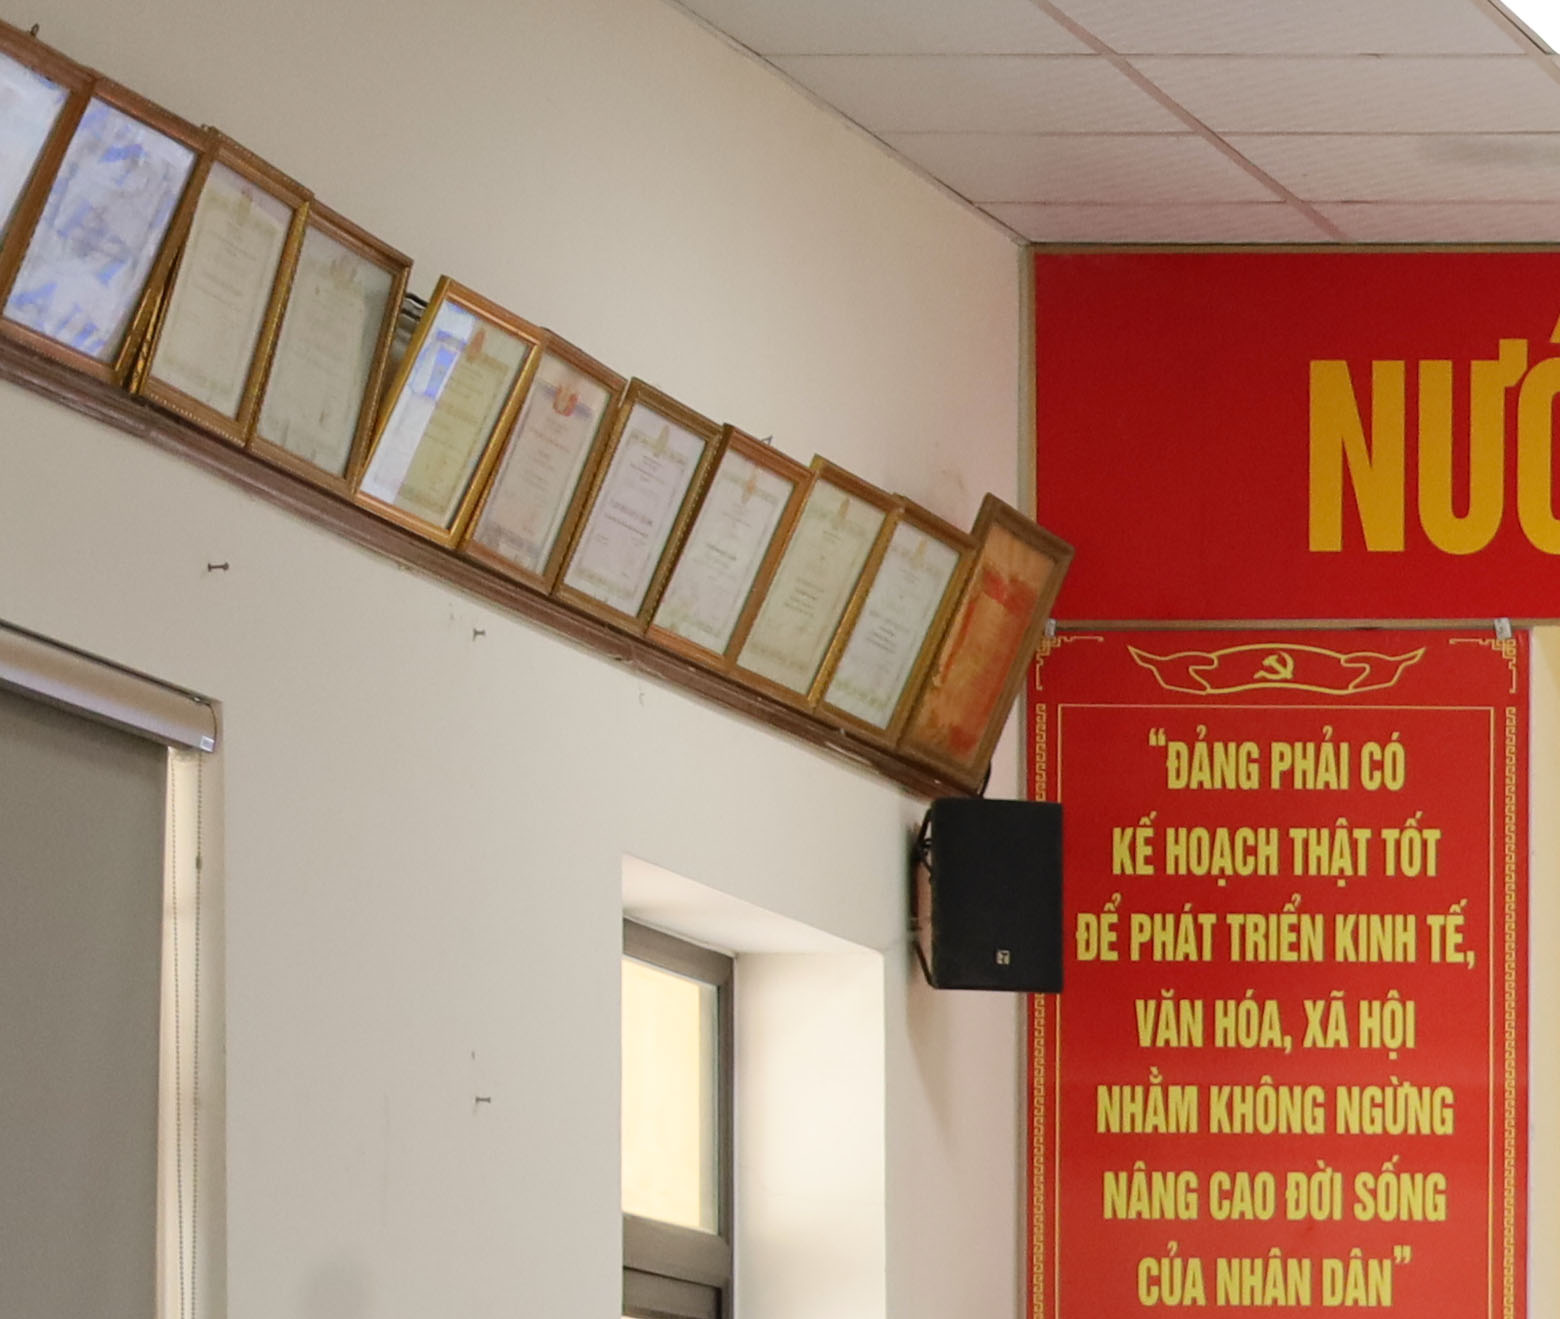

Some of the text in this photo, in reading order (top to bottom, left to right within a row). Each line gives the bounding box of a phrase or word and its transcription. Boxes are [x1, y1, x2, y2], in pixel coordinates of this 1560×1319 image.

[1150, 725, 1404, 790] “ĐẢNG PHẢI CÓ
[1113, 812, 1441, 887] KẾ HOẠCH THẬT TỐT
[1077, 894, 1475, 969] ĐỂ PHÁT TRIỂN KINH TẾ,
[1136, 990, 1415, 1060] VĂN HÓA, XÃ HỘI
[1139, 1241, 1412, 1307] CỦA NHÂN DÂN”
